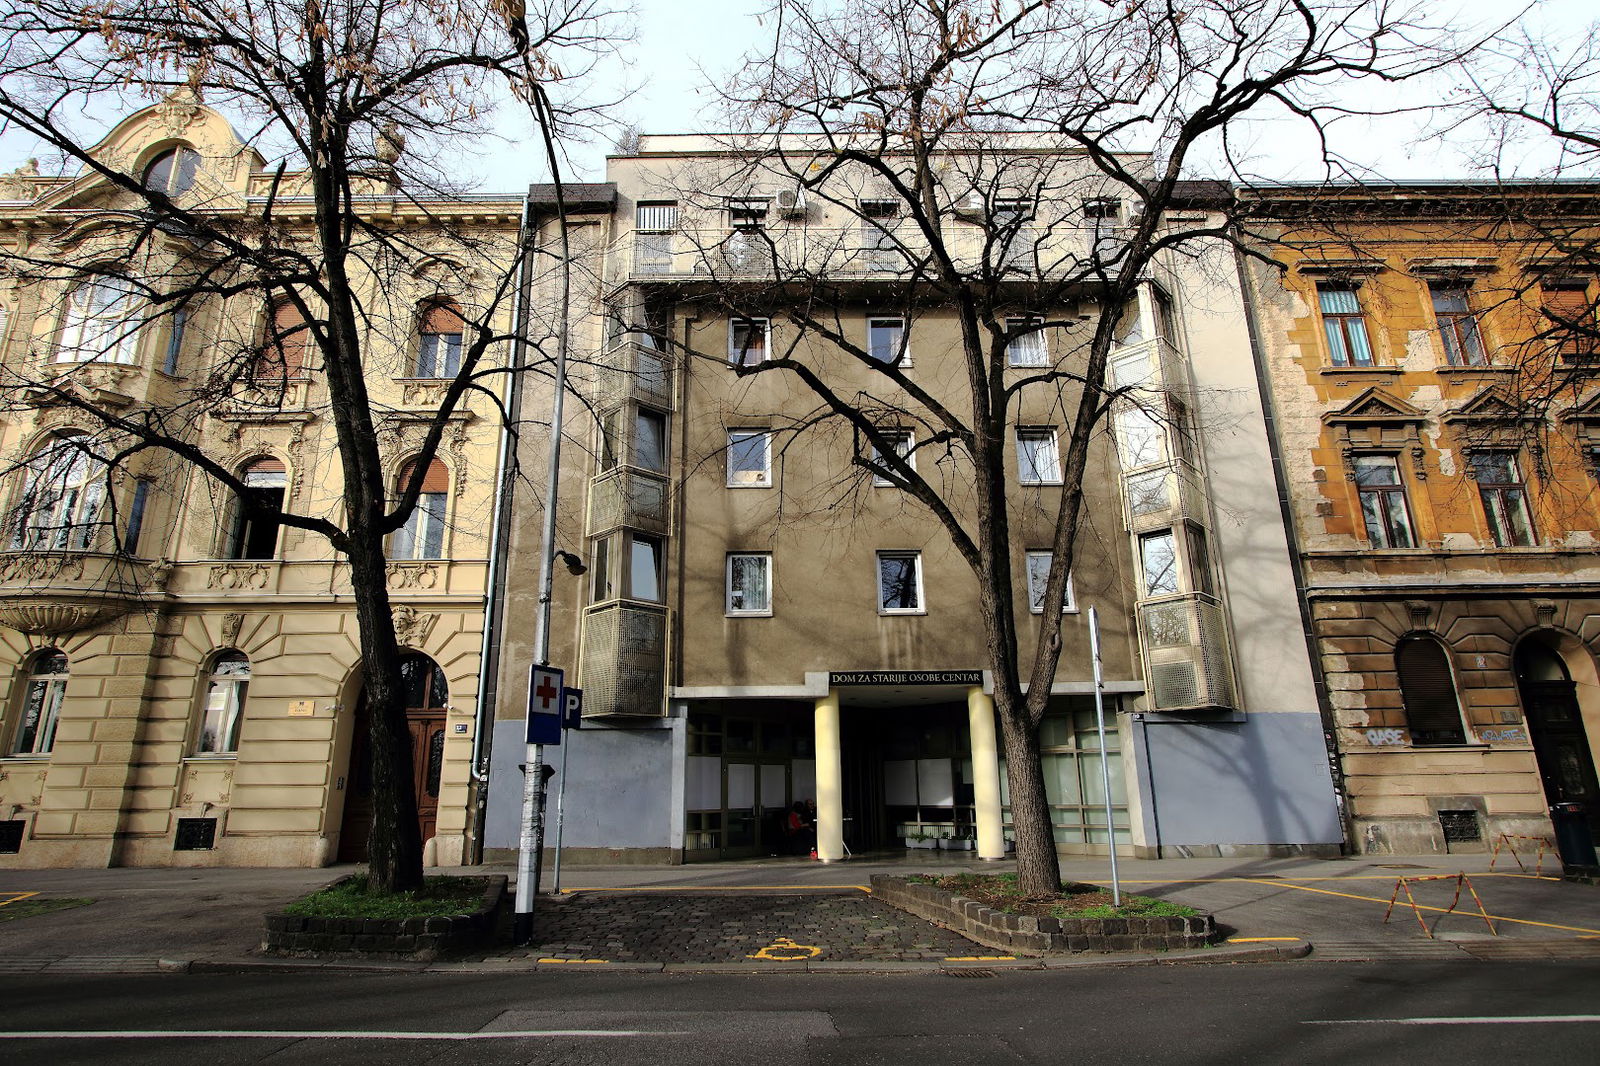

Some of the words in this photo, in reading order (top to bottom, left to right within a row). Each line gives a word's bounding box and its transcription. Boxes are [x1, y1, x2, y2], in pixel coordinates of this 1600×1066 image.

[832, 674, 856, 683] DOM
[858, 674, 871, 683] ZA
[873, 674, 907, 684] STARIJE
[909, 673, 941, 682] OSOBE
[942, 673, 980, 682] CENTAR
[565, 694, 580, 720] P
